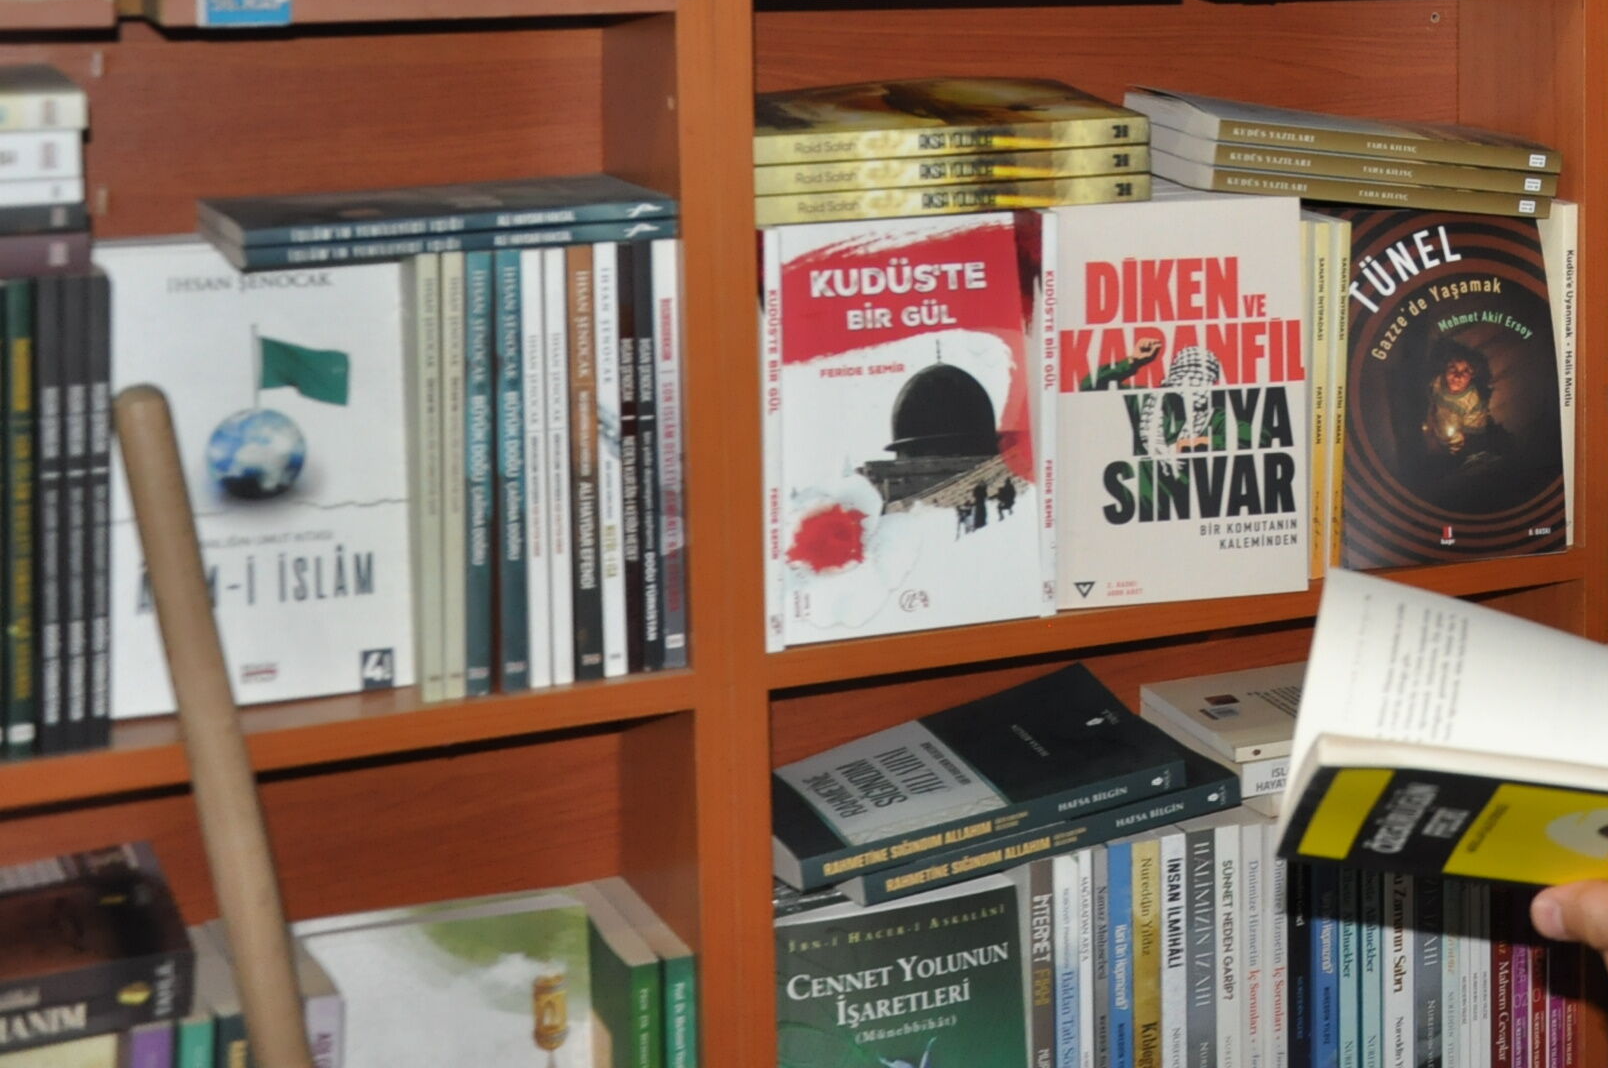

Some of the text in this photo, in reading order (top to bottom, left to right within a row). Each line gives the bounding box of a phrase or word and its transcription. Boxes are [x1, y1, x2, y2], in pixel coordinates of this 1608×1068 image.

[809, 258, 987, 299] KUDÜS'TE
[1085, 257, 1267, 325] DİKEN VE
[1349, 225, 1462, 314] TÜNEL
[847, 299, 957, 330] BİR GÜL
[1371, 277, 1502, 361] Gazze'de Yaşamak
[1437, 310, 1533, 341] Mehmet Akif Ersoy
[1564, 290, 1574, 338] Uyanmak
[820, 362, 905, 379] FERİDE SEMİR
[1059, 317, 1306, 393] KARANFİL
[1565, 350, 1573, 375] Halis
[1102, 452, 1296, 526] SİNVAR
[1200, 519, 1298, 536] BİR KOMUTANIN
[1219, 534, 1298, 550] KALEMİNDEN
[278, 544, 376, 604] İSLÂM
[1058, 796, 1090, 812] HAFSA
[1091, 786, 1128, 803] BİLGİN
[1116, 813, 1148, 828] HAFSA
[1149, 802, 1184, 819] BİLGİN
[1167, 858, 1182, 903] İNSAN
[1141, 858, 1152, 956] Nureddin Yıldız
[1223, 860, 1234, 1001] SÜNNET NEDEN GARİP?
[786, 942, 1009, 1000] CENNET YOLUNUN
[836, 978, 971, 1029] İŞARETLERİ
[1494, 962, 1510, 1061] Mahrem Cevaplar
